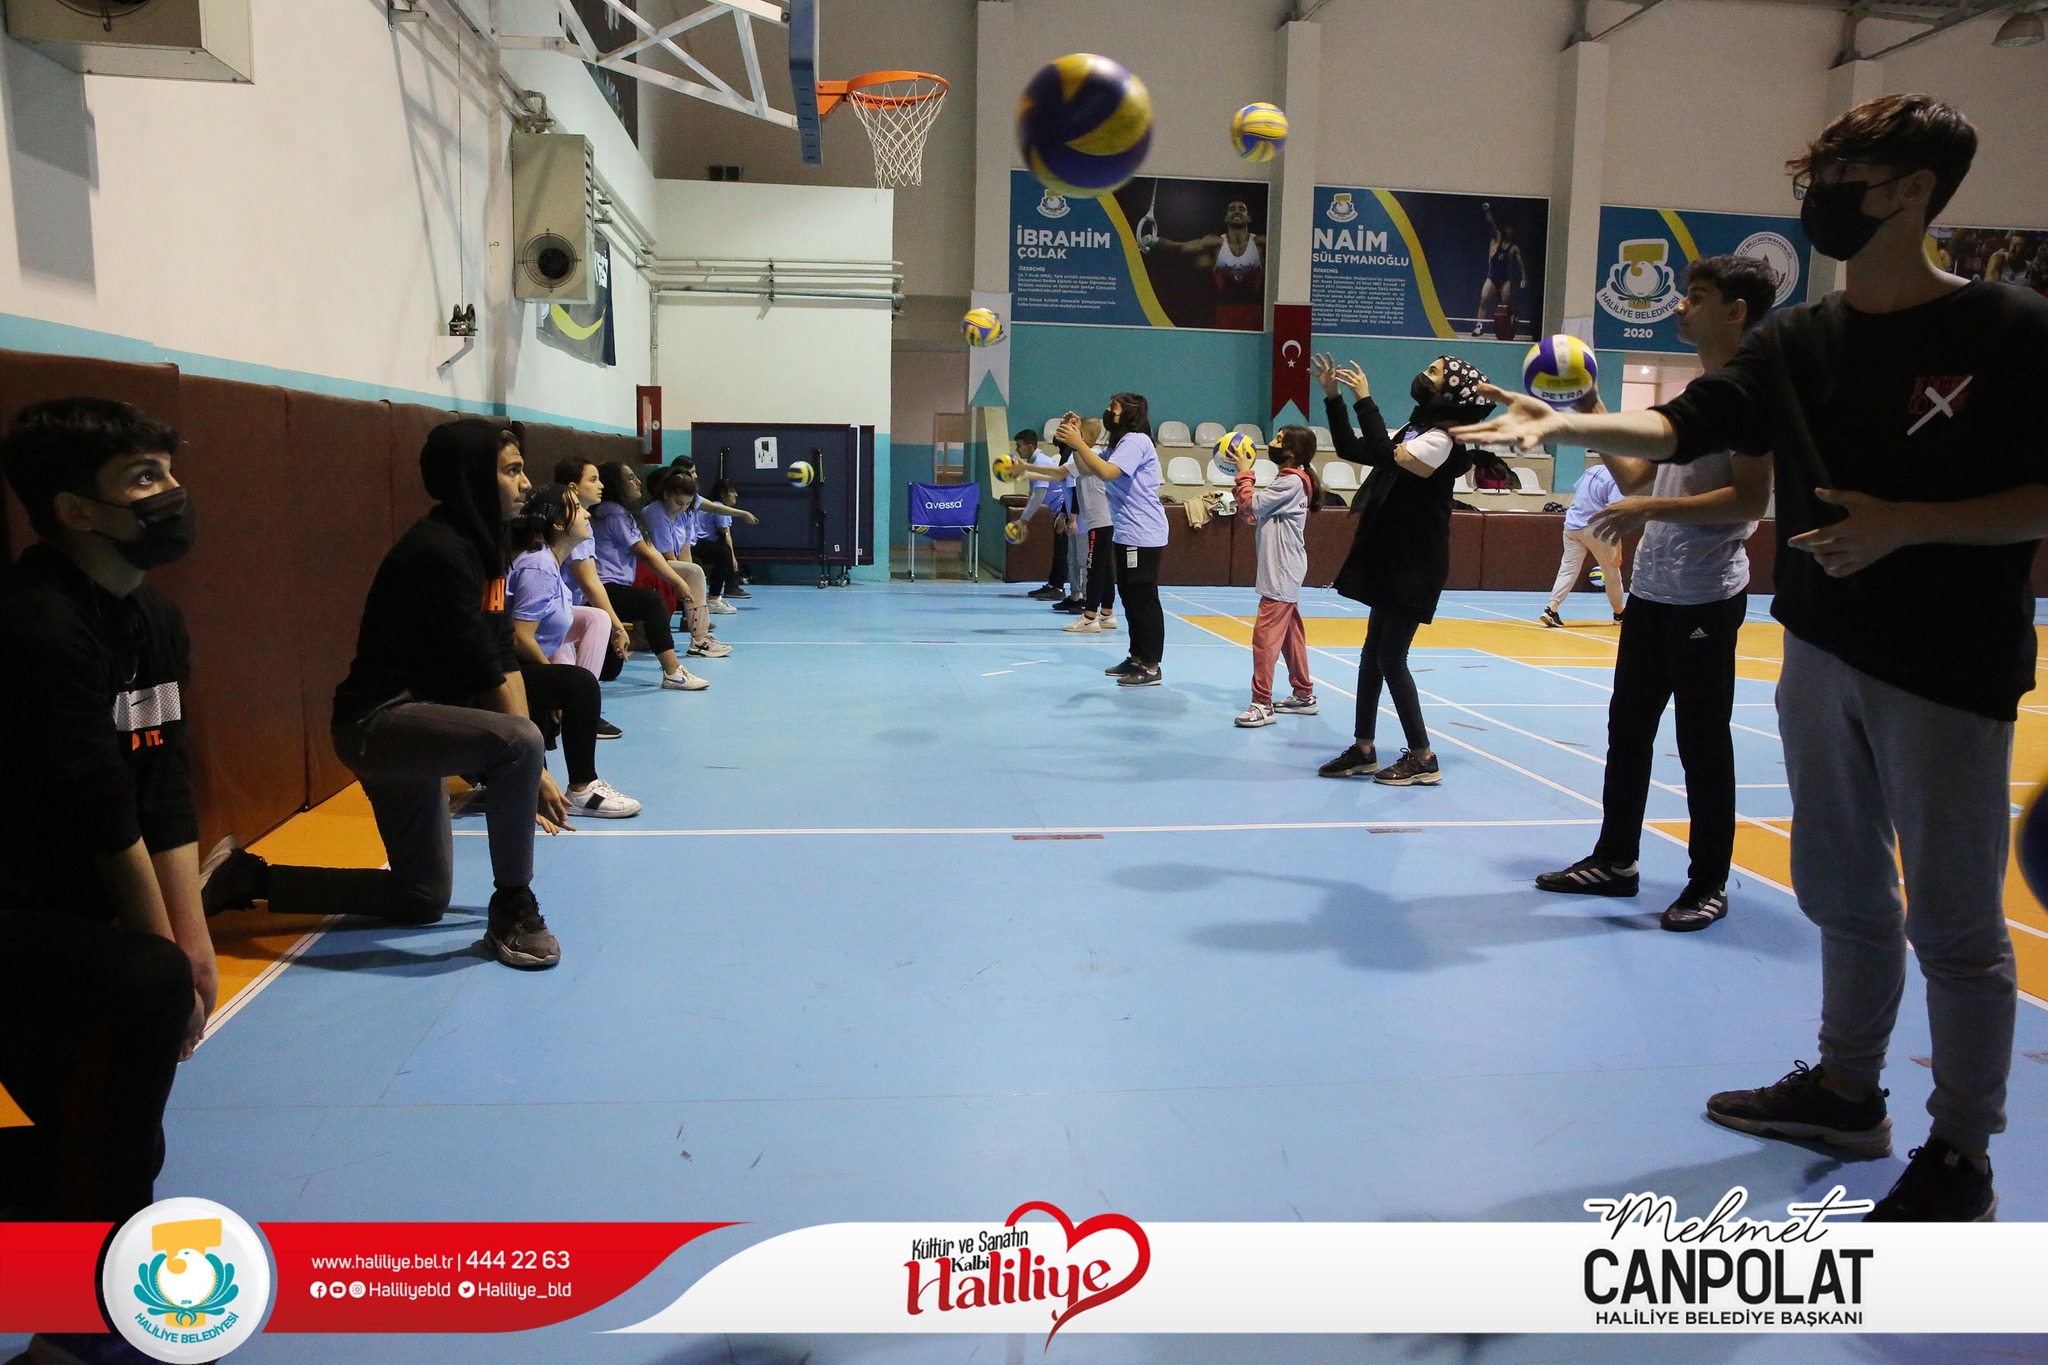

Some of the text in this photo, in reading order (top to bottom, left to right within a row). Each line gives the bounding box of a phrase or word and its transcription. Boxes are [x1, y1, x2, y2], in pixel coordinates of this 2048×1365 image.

[1017, 225, 1111, 248] İBRAHİM
[1313, 225, 1388, 252] NAİM
[1017, 247, 1067, 260] ÇOLAK
[1312, 251, 1410, 266] SÜLEYMANOĞLU
[1601, 292, 1633, 318] HALİLİYE
[1623, 328, 1653, 338] 2020
[1541, 390, 1583, 400] PETRA
[925, 500, 962, 510] avessa
